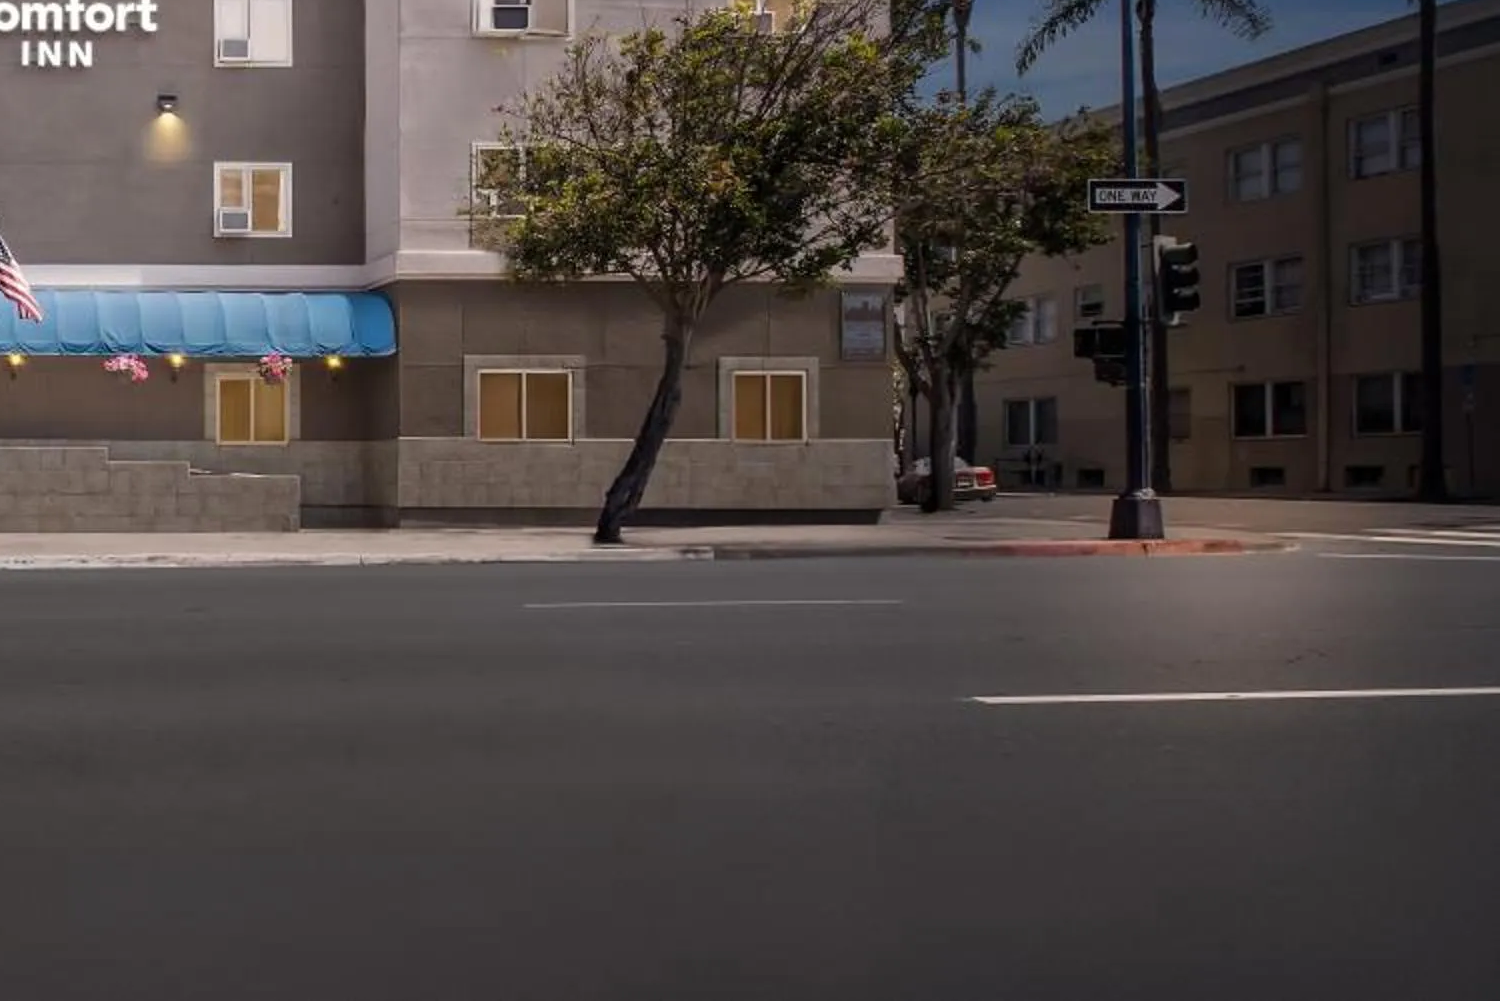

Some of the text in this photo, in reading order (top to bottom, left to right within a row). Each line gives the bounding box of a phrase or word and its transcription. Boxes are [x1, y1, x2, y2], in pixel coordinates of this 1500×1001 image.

[21, 40, 94, 67] INN
[1100, 190, 1157, 202] ONE WAY
